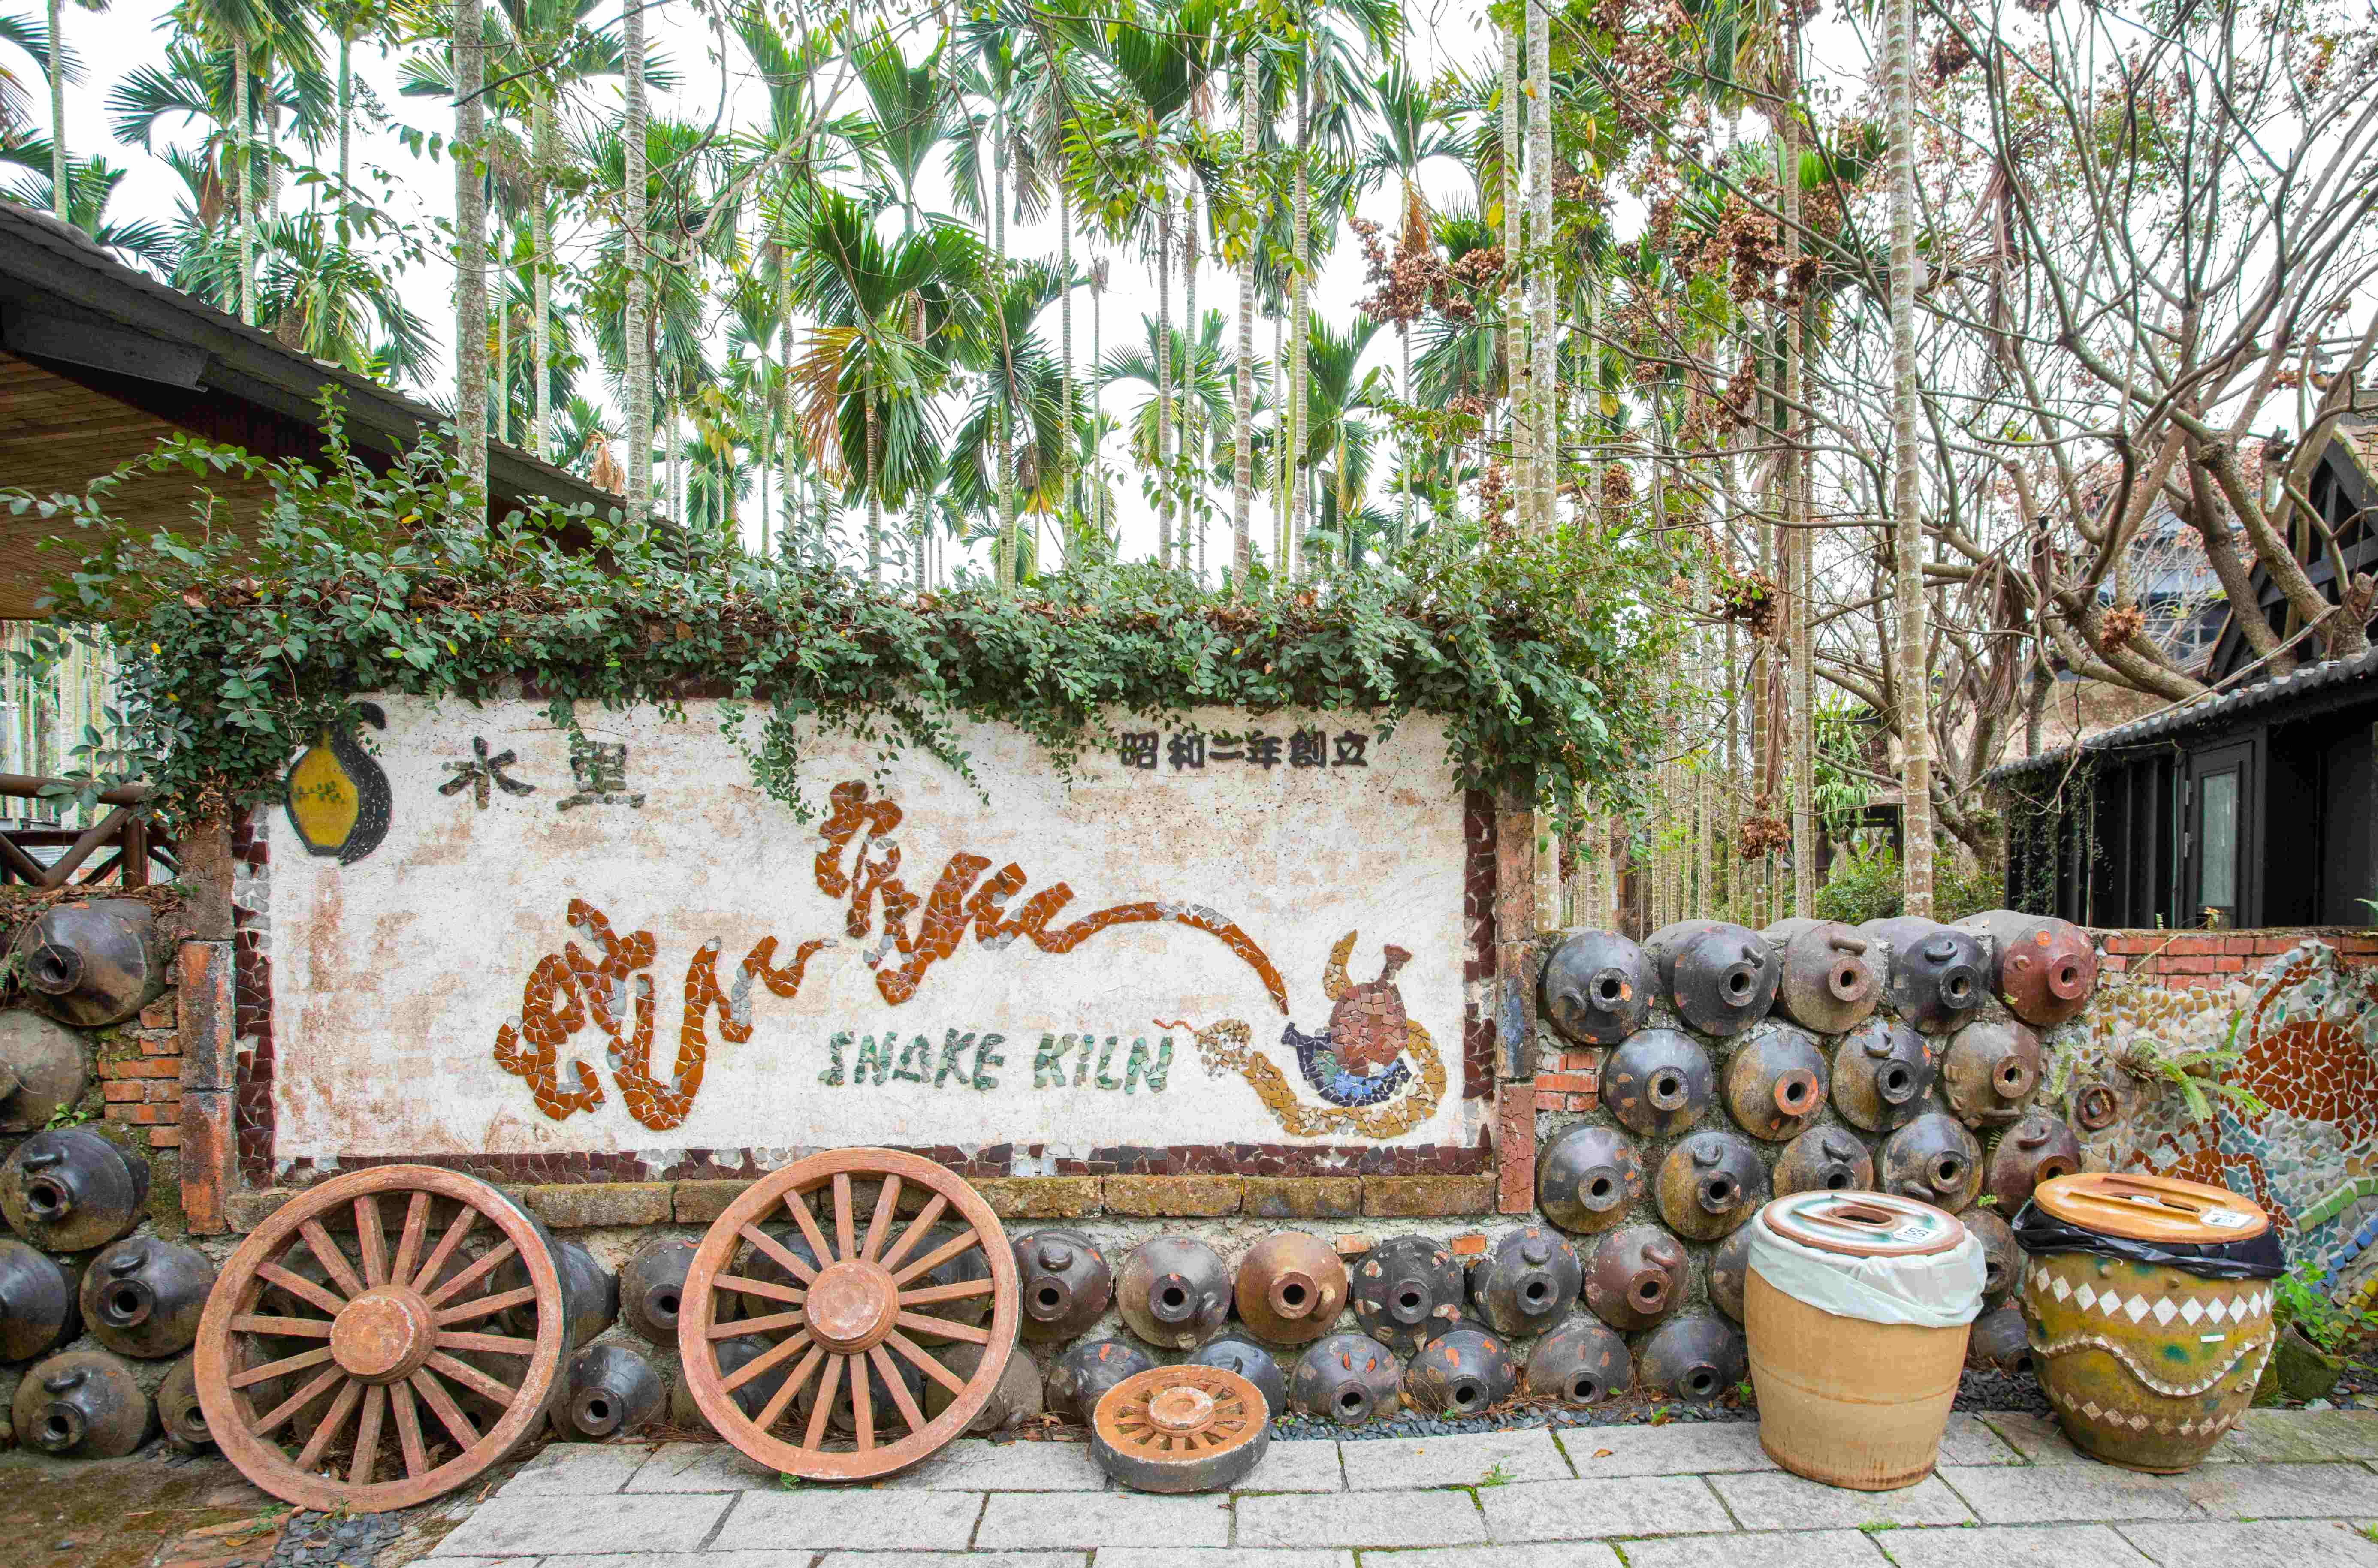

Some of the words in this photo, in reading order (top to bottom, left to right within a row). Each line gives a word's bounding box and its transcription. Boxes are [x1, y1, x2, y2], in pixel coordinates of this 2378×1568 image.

[438, 735, 646, 811] 水里
[1121, 730, 1369, 769] 昭和二年創立
[818, 1028, 1006, 1091] SNAKE
[1033, 1032, 1174, 1095] KILN
